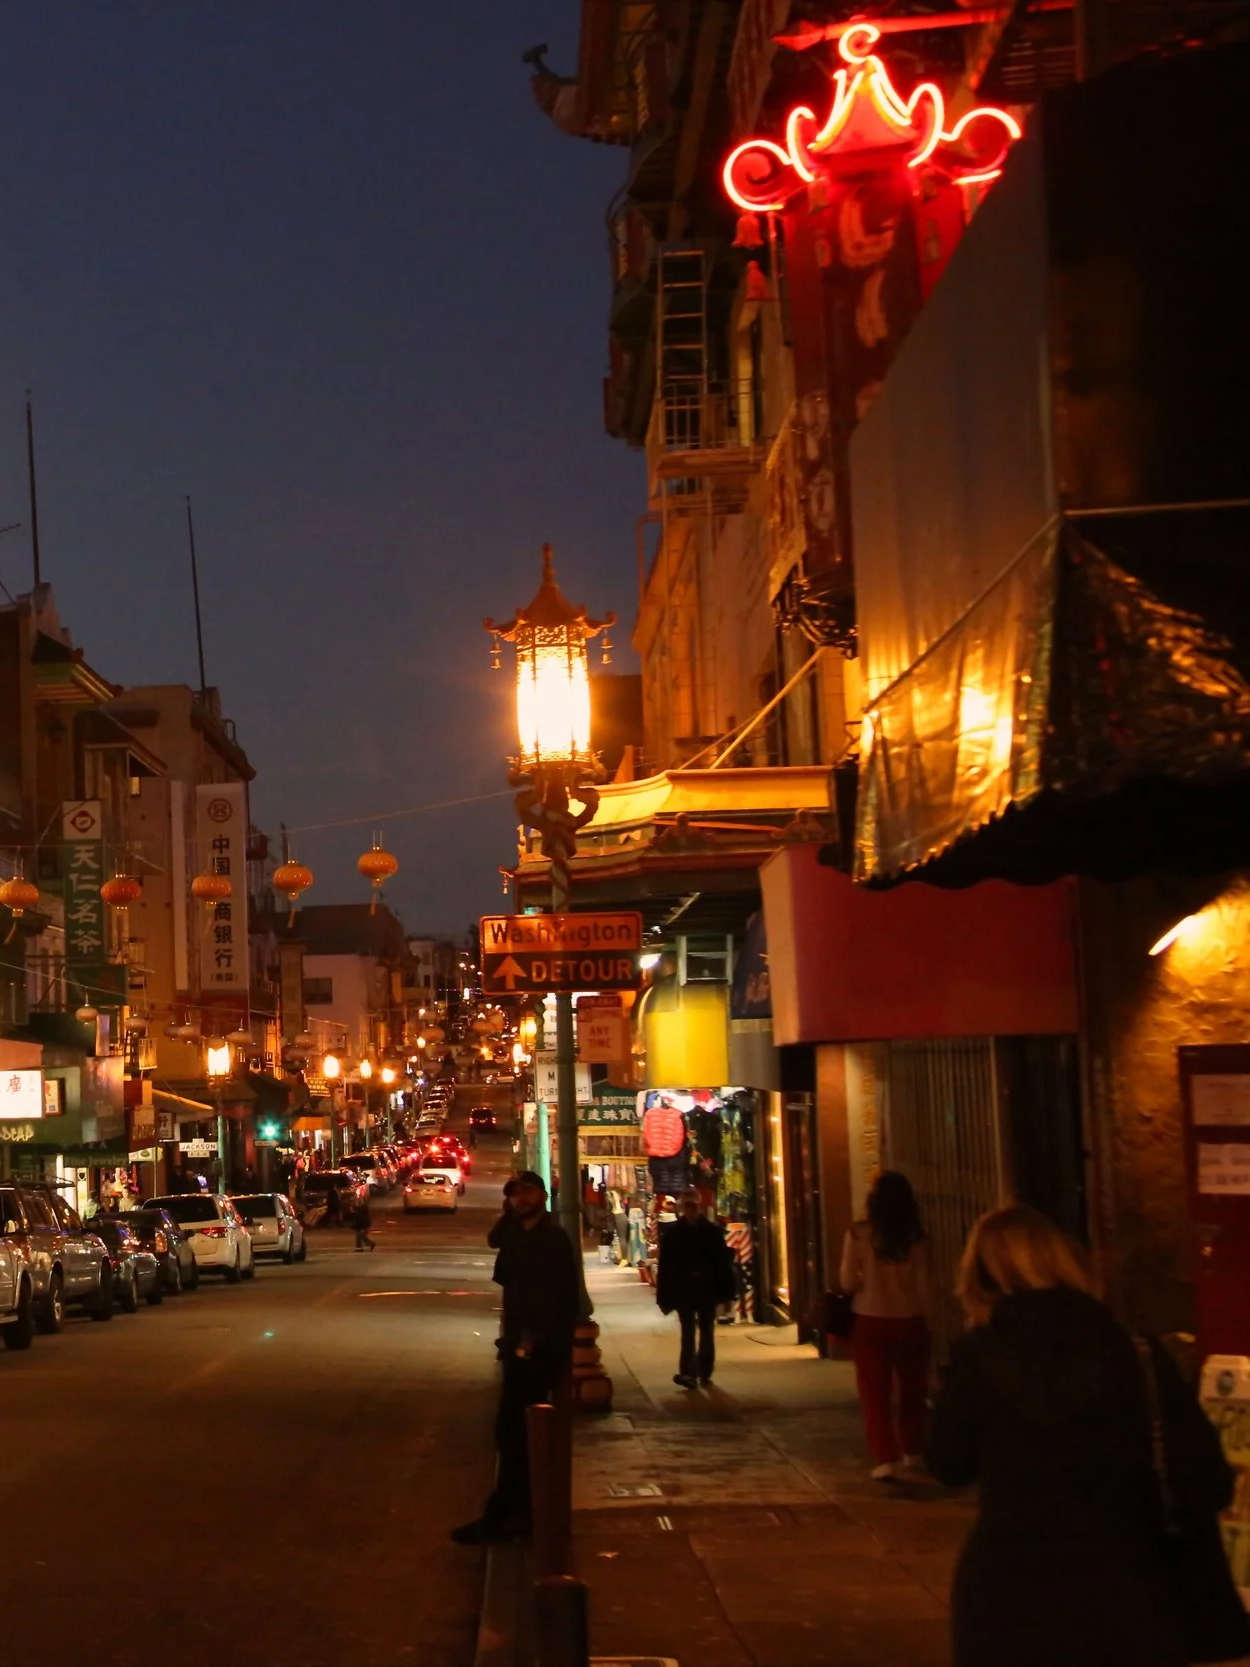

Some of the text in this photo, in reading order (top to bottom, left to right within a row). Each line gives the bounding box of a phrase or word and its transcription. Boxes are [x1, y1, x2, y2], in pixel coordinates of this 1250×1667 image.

[67, 844, 103, 954] 天仁茗茶
[212, 834, 234, 968] 中国商银行
[490, 921, 632, 947] Washington
[531, 959, 633, 983] DETOUR
[589, 1025, 610, 1035] ANY
[587, 1038, 612, 1049] TIME
